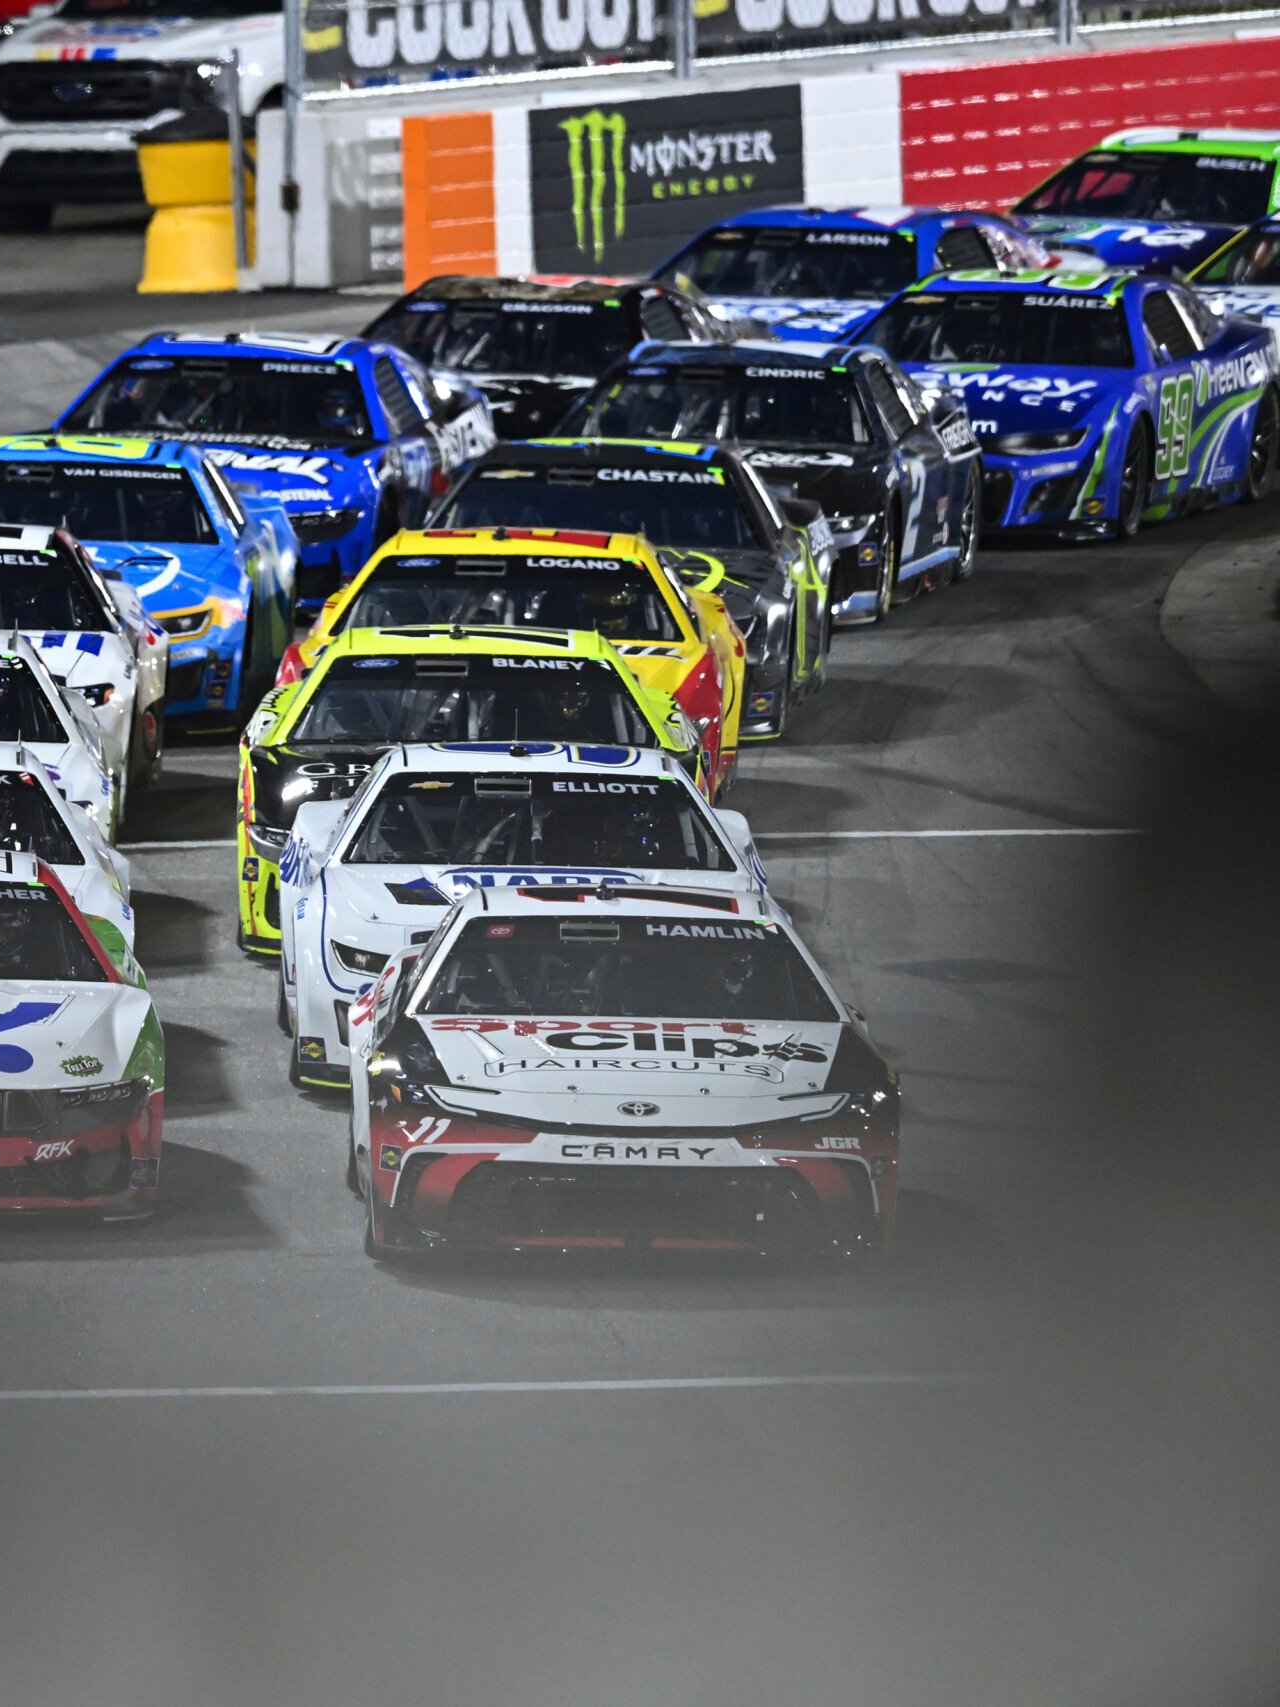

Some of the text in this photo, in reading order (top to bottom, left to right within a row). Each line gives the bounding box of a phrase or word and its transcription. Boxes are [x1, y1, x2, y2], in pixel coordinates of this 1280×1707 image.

[1195, 157, 1266, 171] BUSCH
[651, 174, 754, 199] ENERGY
[805, 234, 890, 246] LARSON
[261, 361, 337, 375] PREECE
[745, 366, 826, 380] CINDRIC
[1155, 372, 1195, 481] 99
[63, 467, 182, 480] VAN GISBERGEN
[597, 467, 718, 484] CHASTAIN
[526, 556, 621, 572] LOGANO
[492, 656, 585, 672] BLANEY
[552, 779, 660, 796] ELLIOTT
[645, 923, 766, 940] HAMLIN
[498, 1059, 772, 1078] HAIRCUTS
[408, 1116, 452, 1144] 11
[34, 1139, 75, 1161] RFK
[814, 1136, 862, 1150] JGR
[561, 1143, 716, 1161] CAMRY
